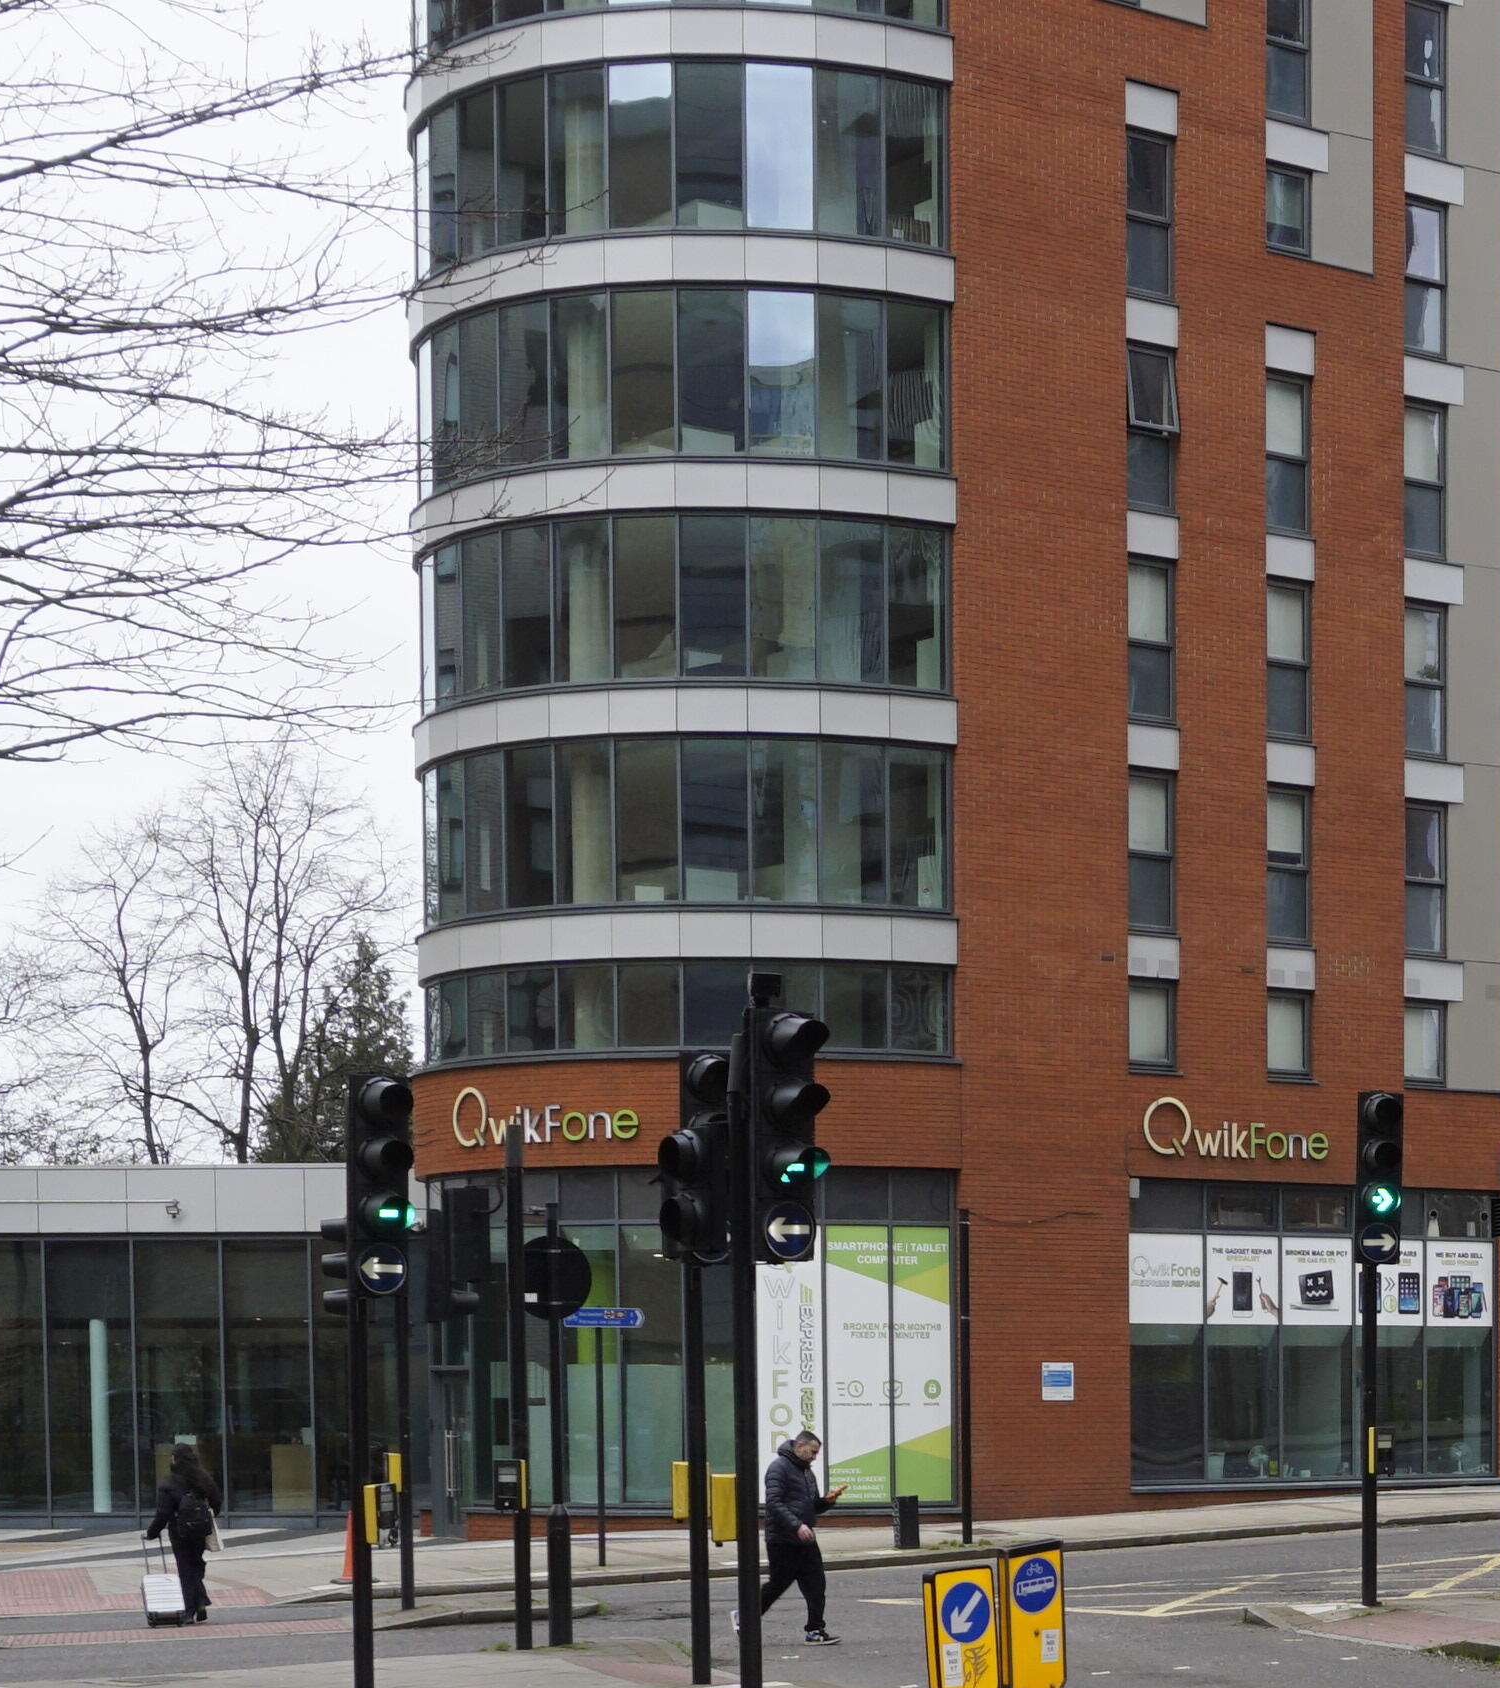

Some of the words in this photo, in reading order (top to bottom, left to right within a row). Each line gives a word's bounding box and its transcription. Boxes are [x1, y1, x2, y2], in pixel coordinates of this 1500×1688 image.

[453, 1087, 640, 1147] QwikFone
[1143, 1096, 1330, 1160] QwikFone
[910, 1243, 949, 1252] TABLET
[800, 1304, 815, 1384] EXPRESS
[800, 1387, 816, 1431] REPA
